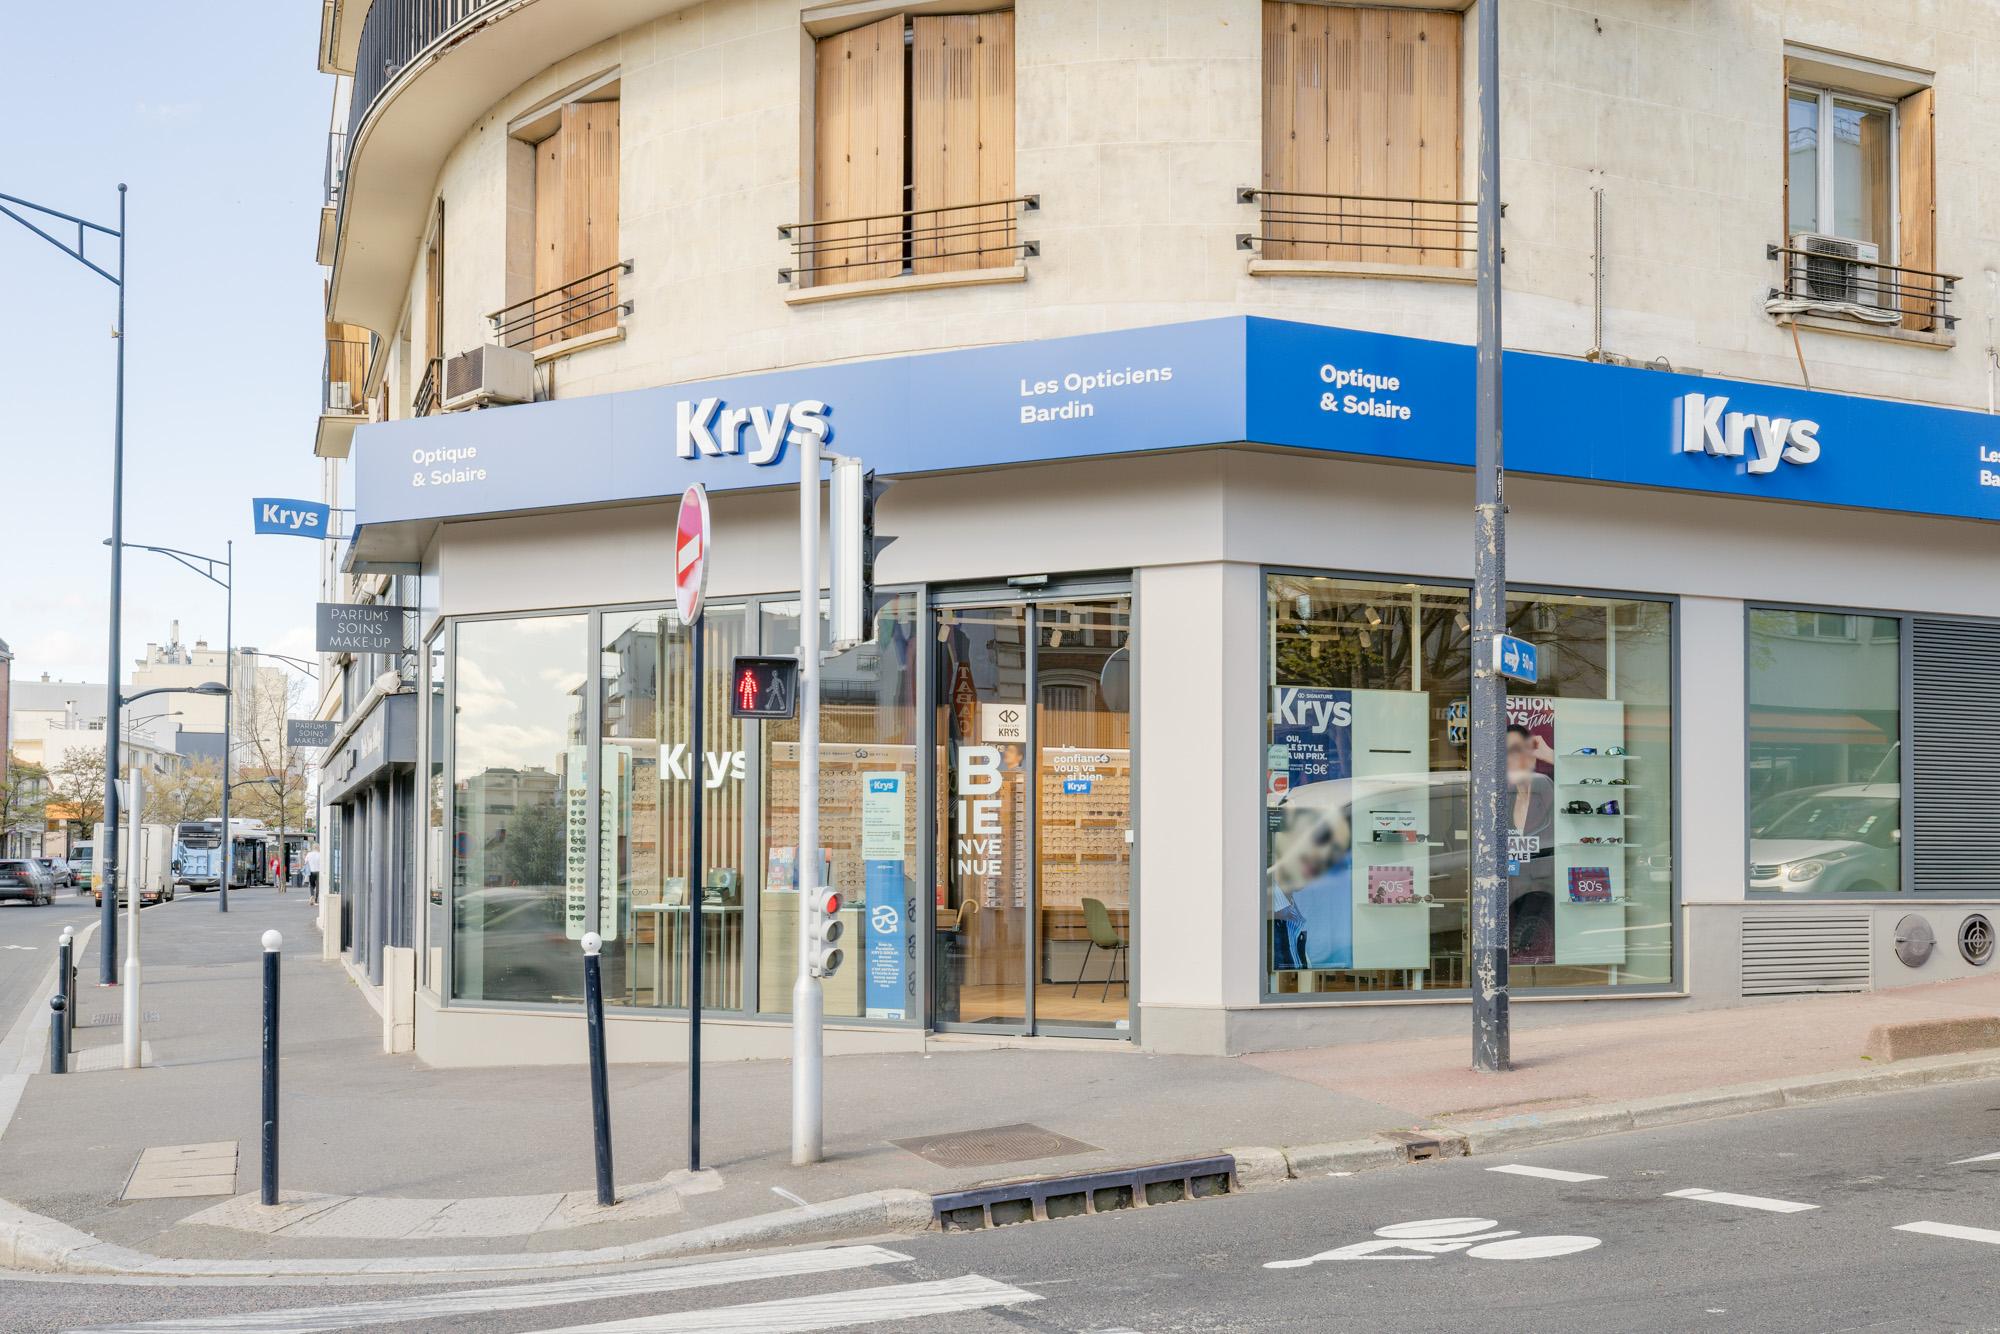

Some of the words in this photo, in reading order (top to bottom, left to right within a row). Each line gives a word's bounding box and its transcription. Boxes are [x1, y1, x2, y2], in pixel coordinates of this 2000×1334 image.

[1020, 379, 1059, 397] Les
[1063, 366, 1173, 394] Opticiens
[1320, 363, 1400, 393] Optique
[1020, 400, 1094, 424] Bardin
[1320, 392, 1339, 412] &
[1343, 394, 1411, 420] Solaire
[676, 397, 830, 465] Krys
[1683, 392, 1821, 474] Krys
[412, 446, 477, 467] Optique
[1980, 445, 2000, 463] Le
[412, 472, 426, 487] &
[431, 467, 487, 485] Solaire
[262, 503, 319, 529] Krys
[331, 609, 389, 622] PARFUMS
[337, 622, 383, 635] SOINS
[330, 637, 391, 649] MAKE-UP
[1273, 687, 1352, 734] Krys
[295, 722, 328, 730] PARFUMS
[998, 728, 1020, 738] KRYS
[300, 730, 325, 738] SOINS
[1286, 735, 1302, 744] OUI,
[1297, 744, 1324, 752] STYLE
[1054, 753, 1109, 764] confiance
[1293, 752, 1304, 760] UN
[1305, 753, 1328, 761] PRIX.
[958, 745, 1003, 796] B
[1054, 765, 1080, 773] vous
[1082, 765, 1097, 773] va
[1067, 772, 1076, 781] si
[1079, 772, 1103, 781] bien
[873, 780, 895, 792] Krys
[1067, 782, 1088, 792] Krys
[958, 799, 1003, 835] IE
[958, 839, 1002, 855] NVE
[958, 859, 1002, 876] NUE
[1579, 880, 1603, 892] 80's
